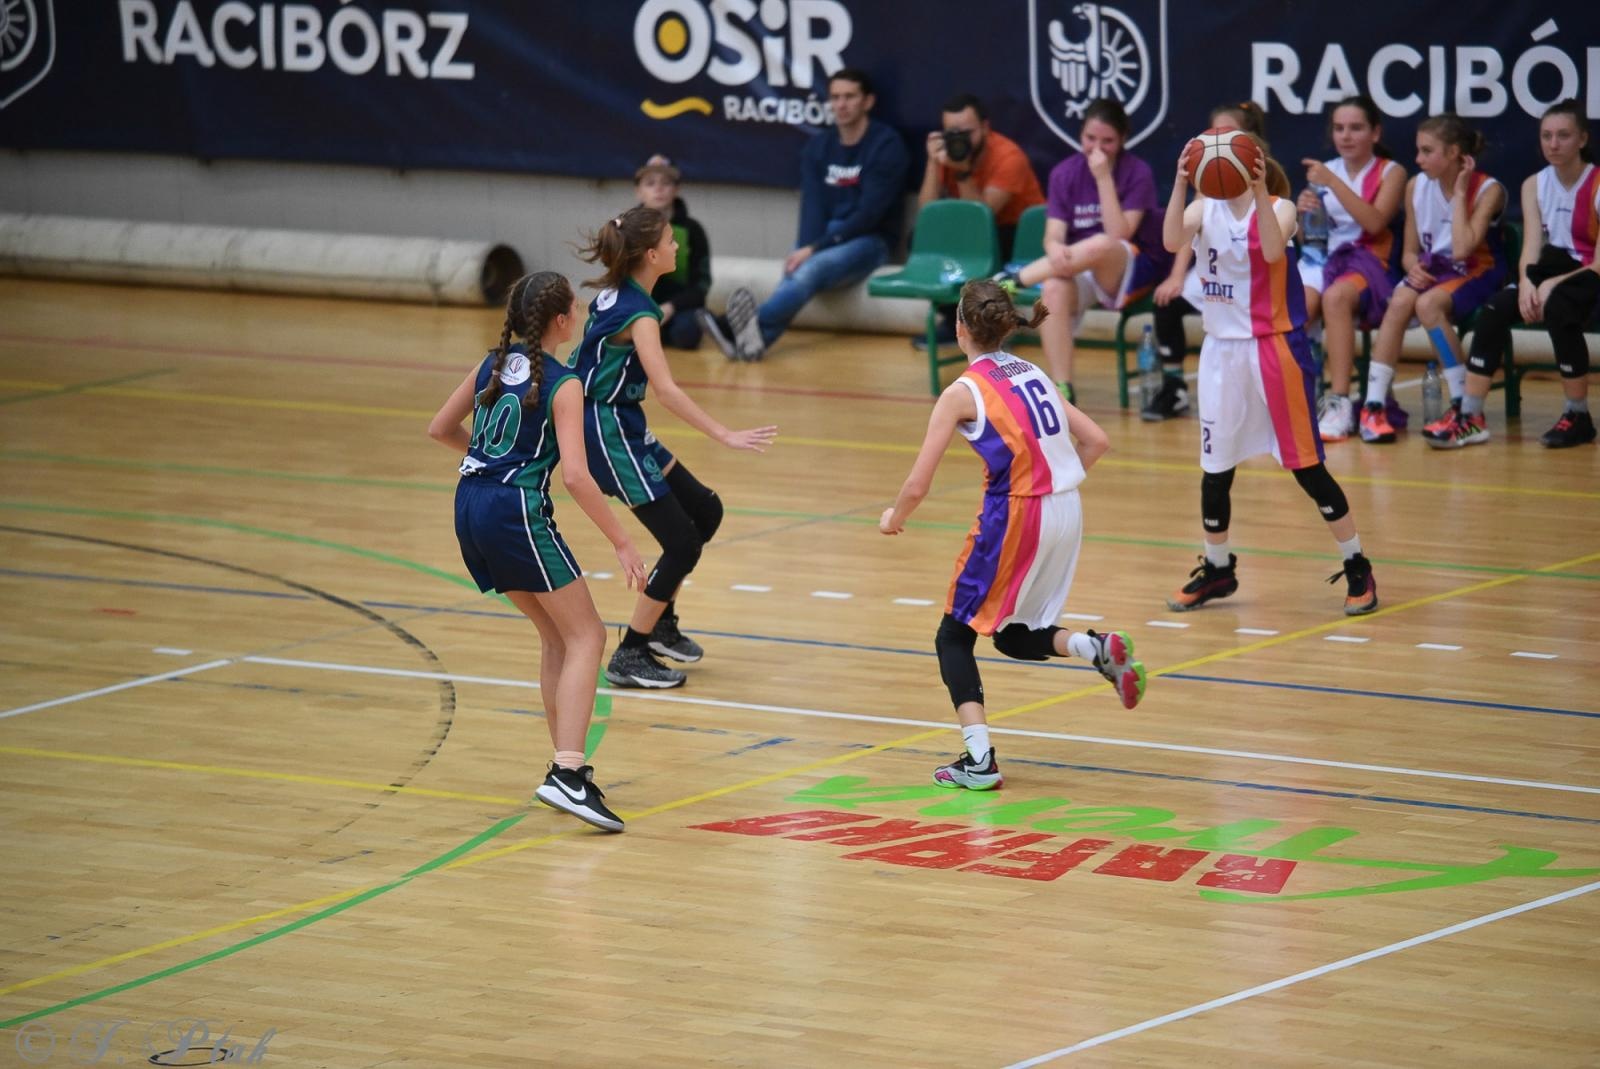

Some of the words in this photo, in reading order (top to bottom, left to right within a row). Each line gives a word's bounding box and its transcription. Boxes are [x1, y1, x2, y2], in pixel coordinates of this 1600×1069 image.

[1252, 18, 1600, 120] RACIBÓ
[723, 93, 834, 126] RACIBÓR
[1208, 248, 1218, 275] 2
[469, 389, 521, 458] 10
[1010, 378, 1061, 439] 16
[1202, 427, 1212, 454] 2
[643, 454, 663, 482] 9
